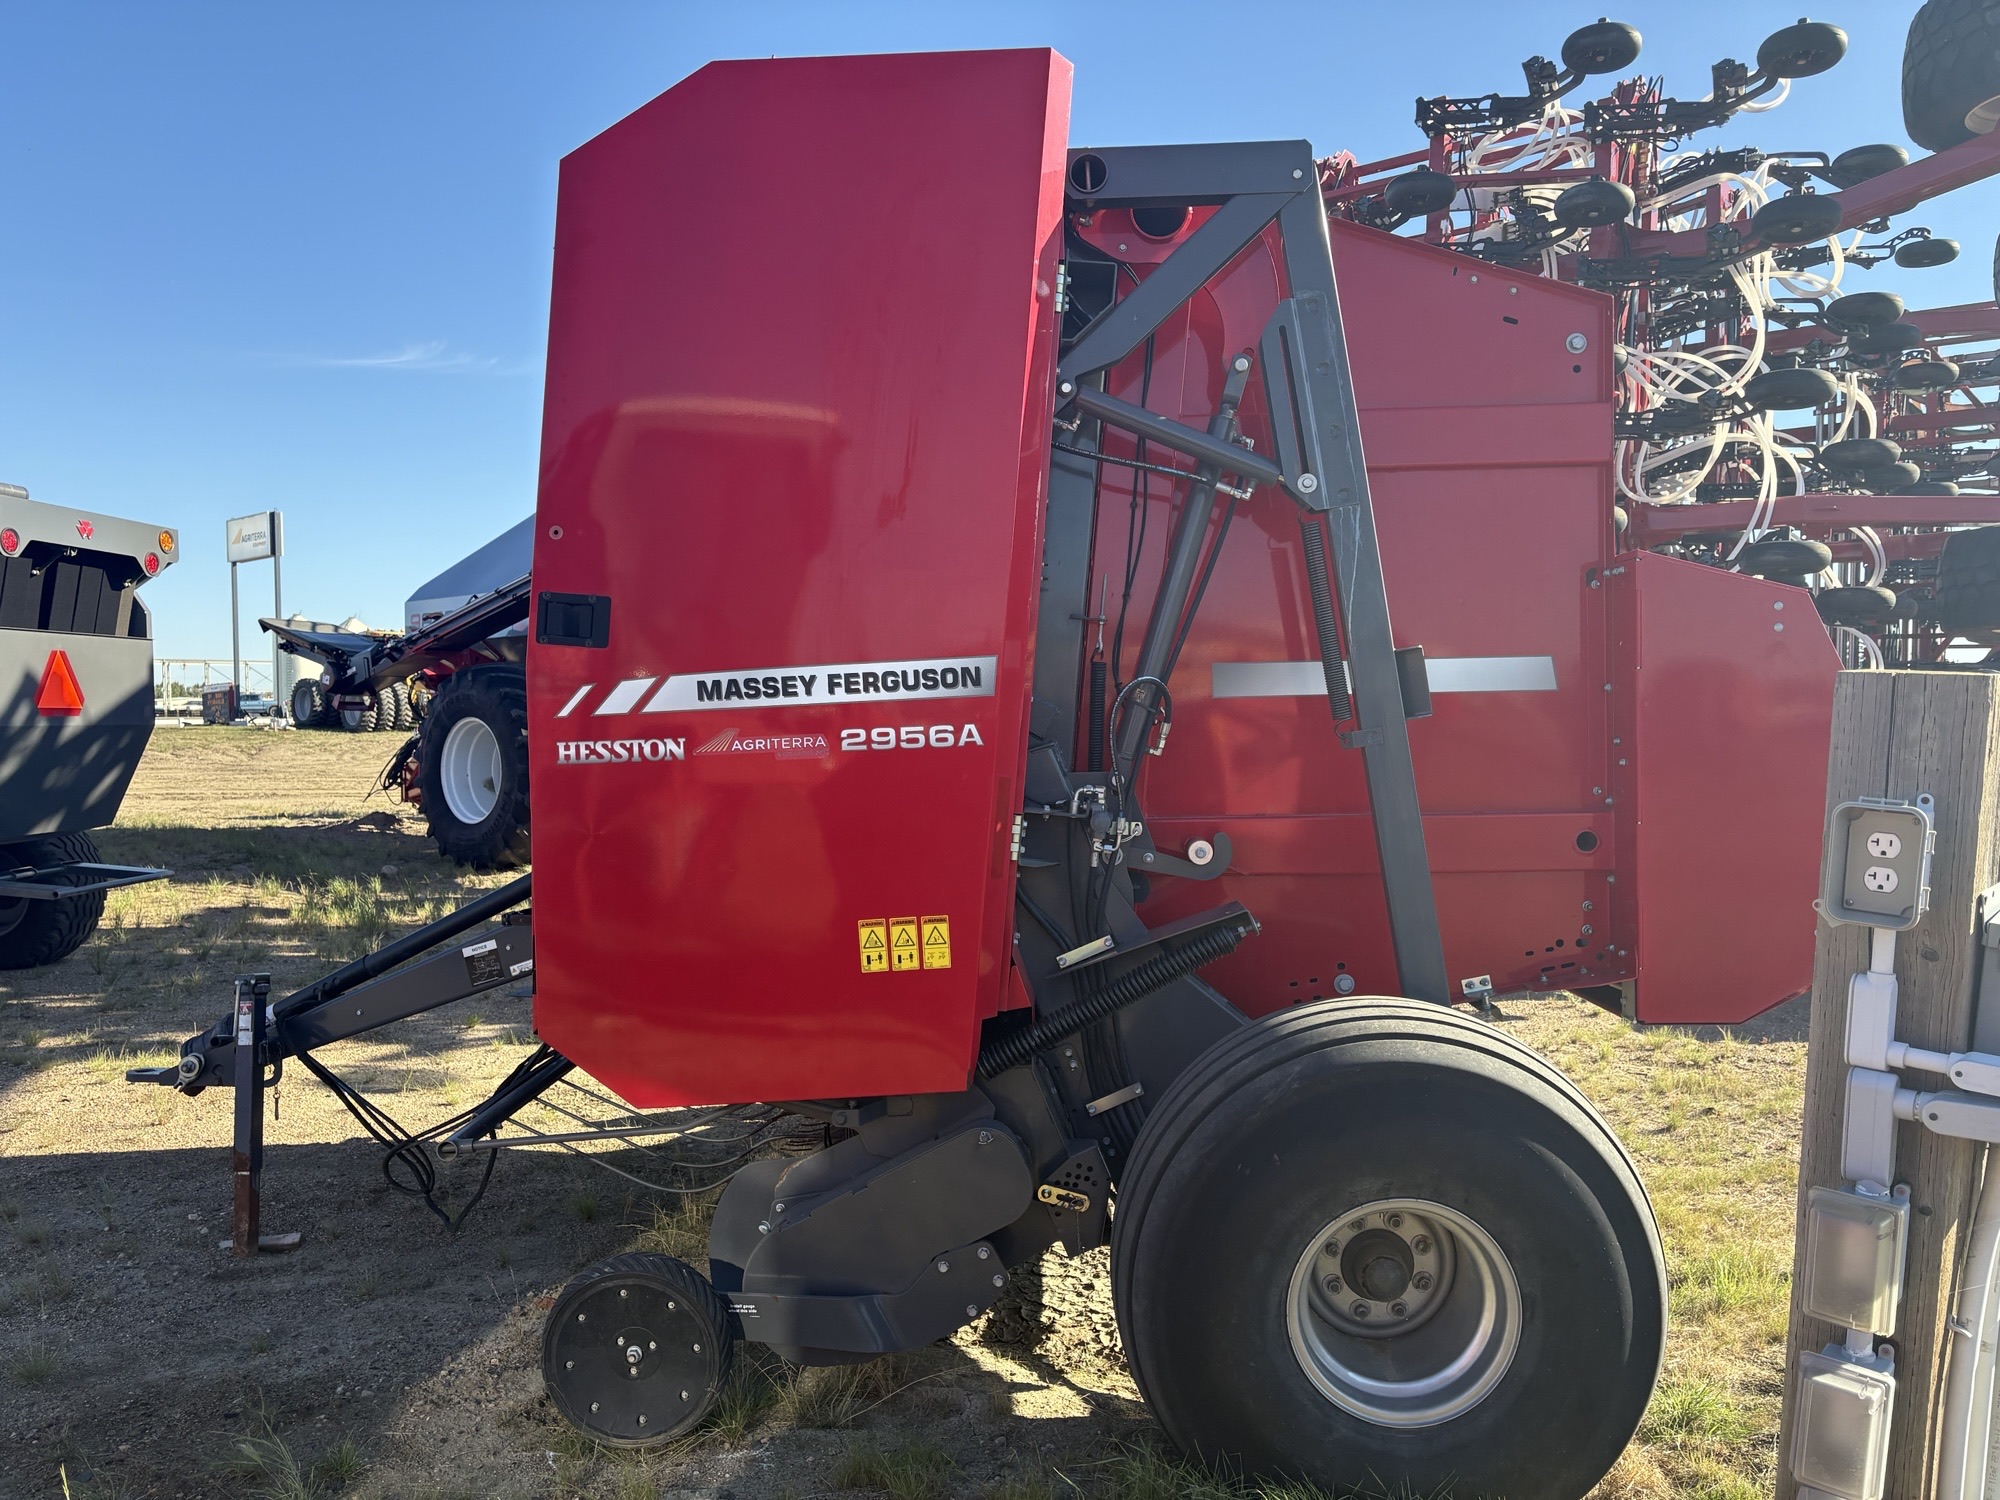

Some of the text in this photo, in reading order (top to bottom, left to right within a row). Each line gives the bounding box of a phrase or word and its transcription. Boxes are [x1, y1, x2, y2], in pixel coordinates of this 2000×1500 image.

[241, 531, 266, 543] AGRITERRA
[697, 666, 981, 702] MASSEY FERGUSON
[731, 736, 827, 752] AGRITERRA
[840, 723, 985, 751] 2956A
[556, 738, 686, 765] HESSTON
[471, 944, 487, 952] NOTICE
